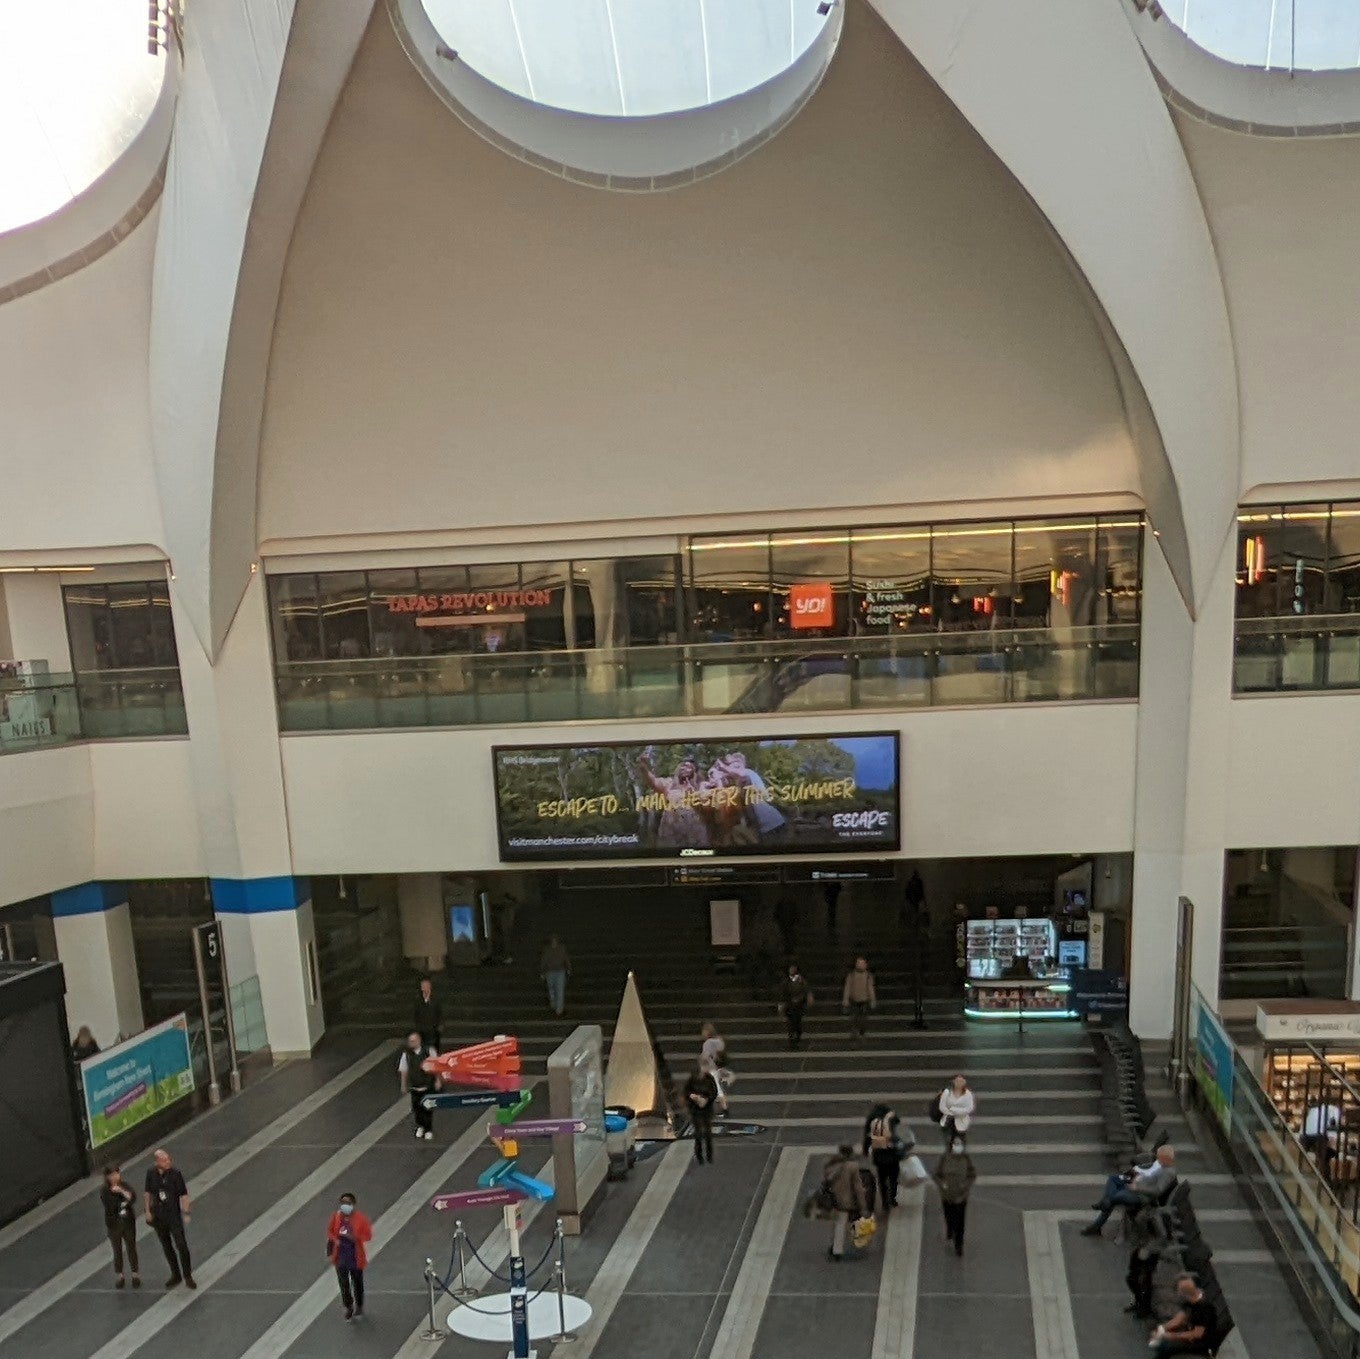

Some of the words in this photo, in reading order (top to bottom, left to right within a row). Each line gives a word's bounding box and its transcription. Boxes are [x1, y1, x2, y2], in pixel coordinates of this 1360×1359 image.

[388, 594, 439, 614] TAPAS
[443, 589, 552, 610] REVOLUTION
[795, 597, 826, 615] YO!
[866, 614, 892, 625] food
[537, 795, 598, 818] ESCAPE
[635, 787, 740, 812] MANCHESTER
[744, 785, 775, 806] THIS
[780, 778, 857, 804] SUMMER
[832, 811, 890, 829] ESCAPE
[508, 833, 639, 849] visitmanchester.com/citybreak
[207, 932, 217, 958] 5
